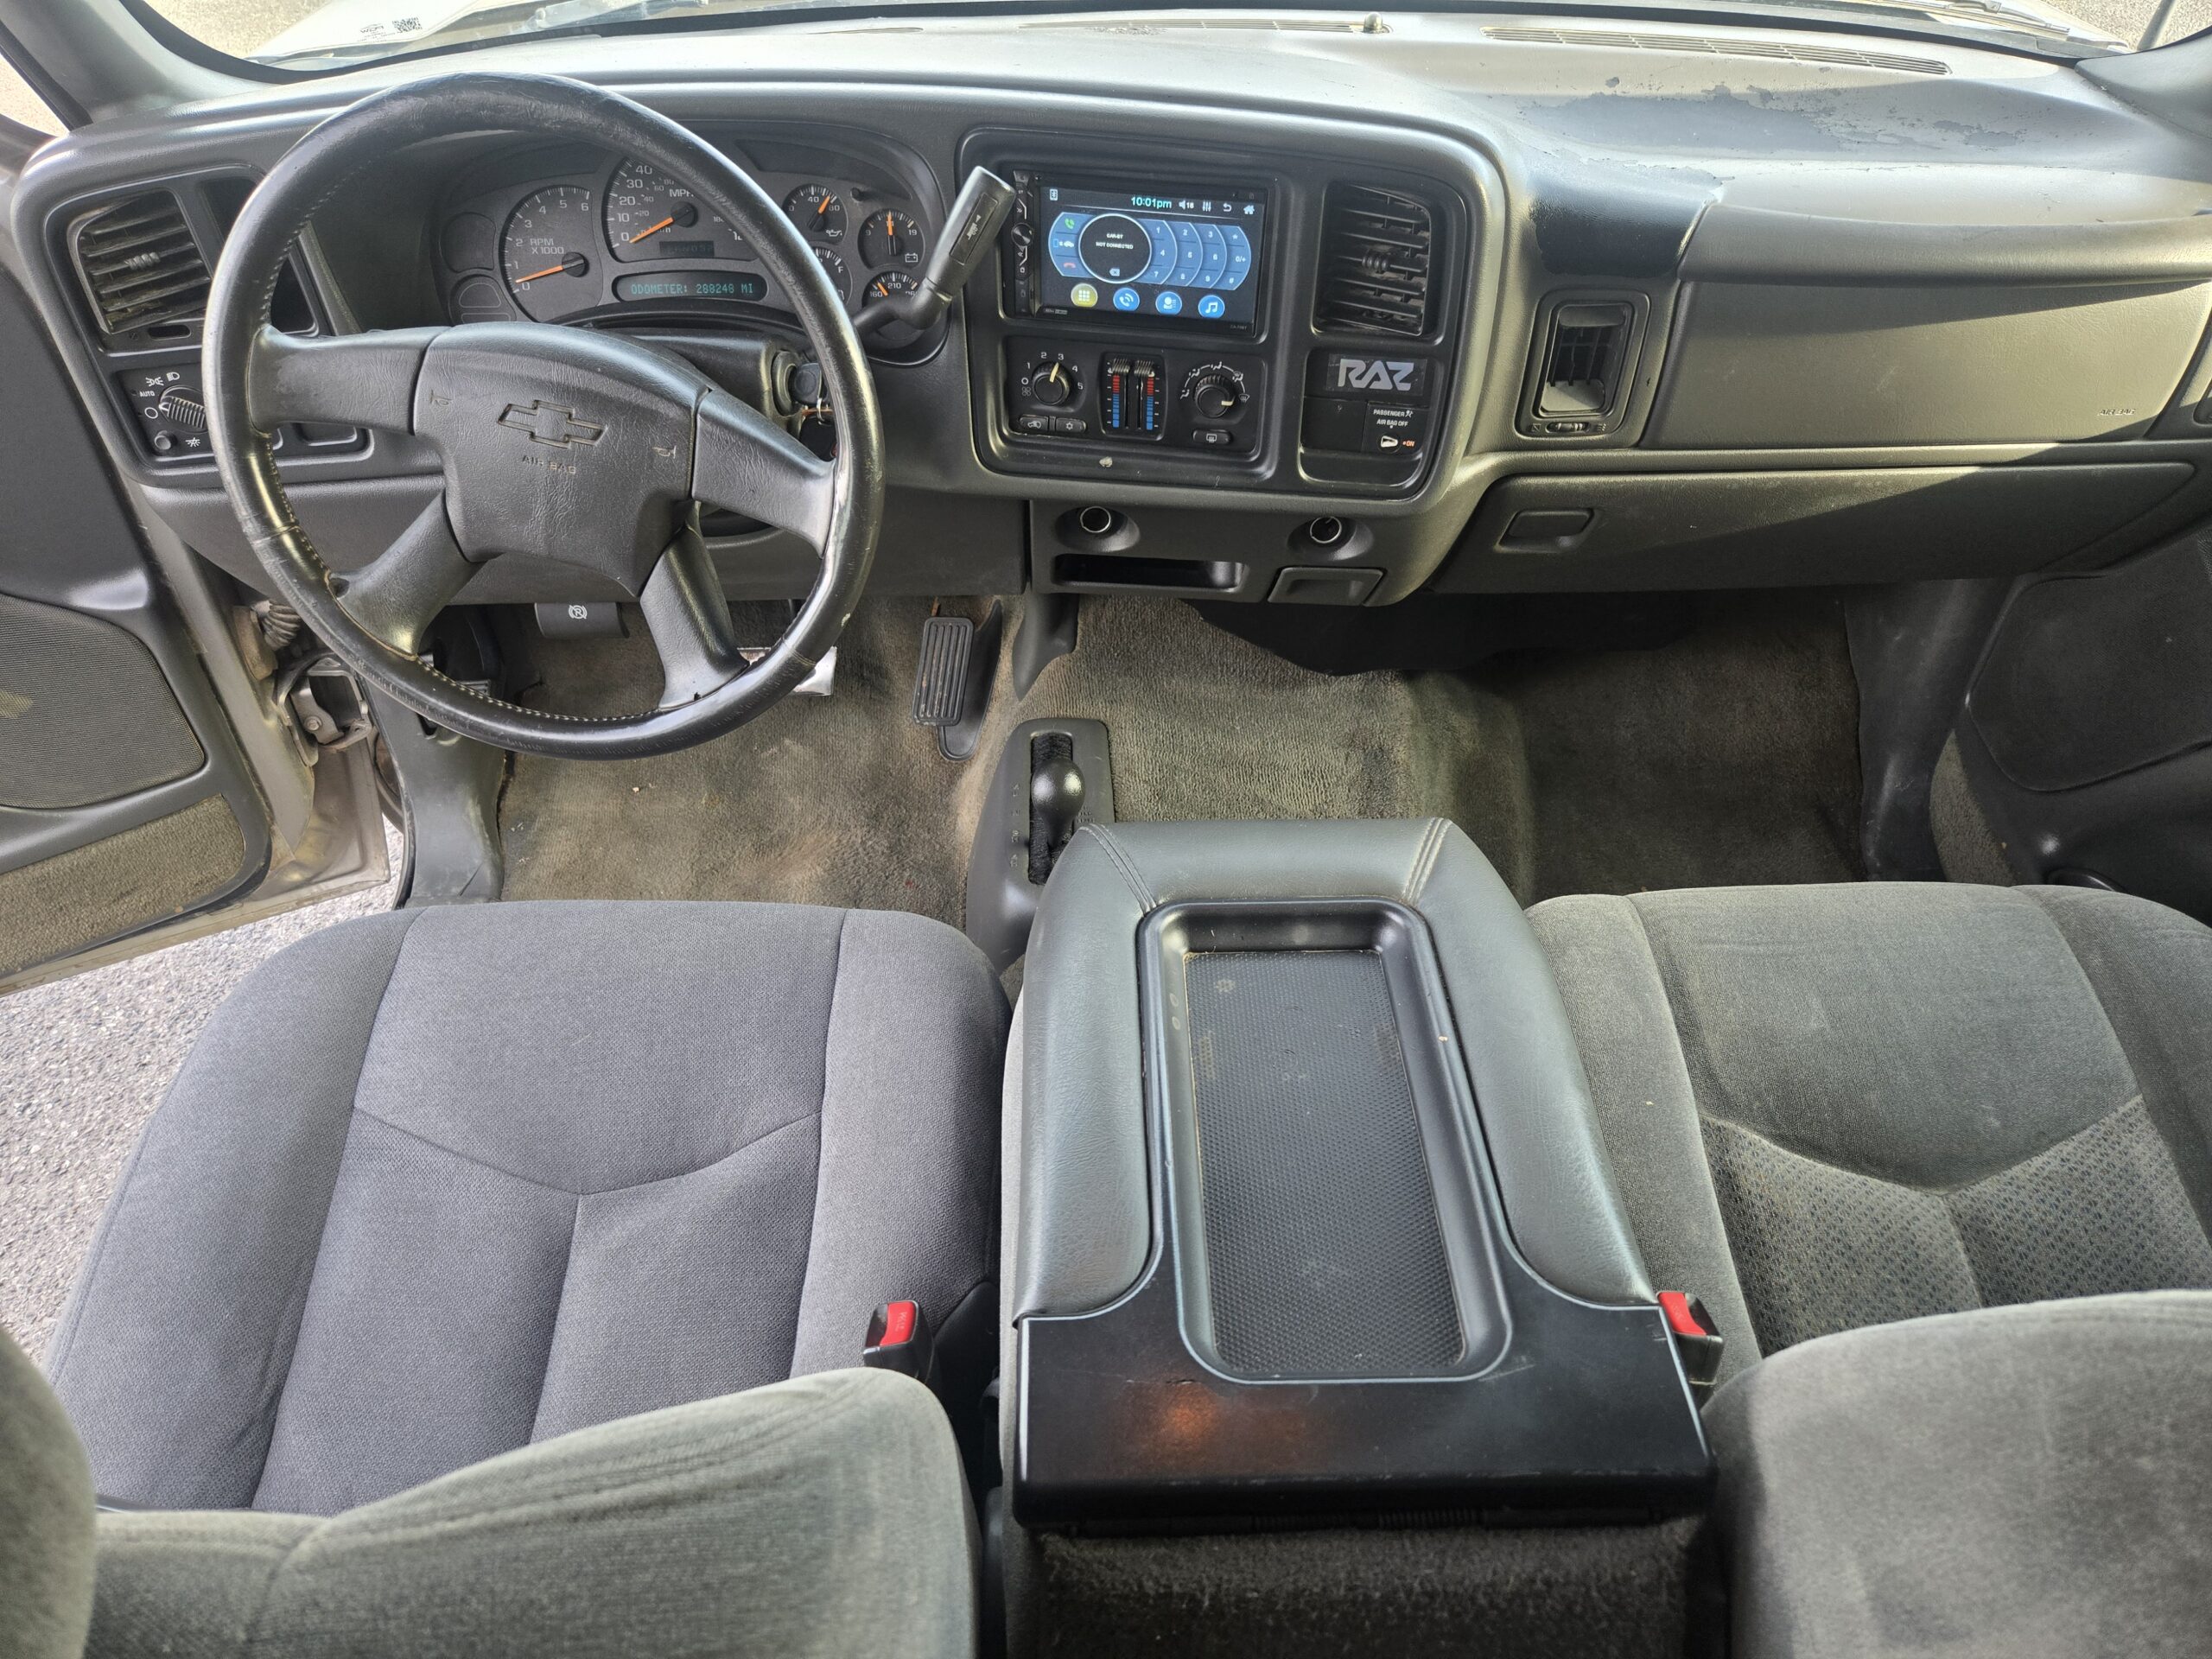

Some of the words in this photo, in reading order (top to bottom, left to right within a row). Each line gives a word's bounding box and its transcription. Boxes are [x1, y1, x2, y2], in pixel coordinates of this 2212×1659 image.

[636, 165, 652, 175] 40
[626, 179, 643, 188] 30
[559, 200, 568, 208] 5
[619, 196, 635, 206] 20
[1131, 196, 1172, 209] 10:01pm
[538, 206, 547, 214] 4
[581, 203, 589, 212] 6
[617, 213, 630, 222] 10
[524, 219, 532, 228] 3
[621, 232, 630, 241] 0
[515, 238, 523, 247] 2
[530, 238, 554, 246] RPM
[514, 261, 518, 270] 1
[522, 282, 530, 290] 0
[631, 283, 688, 295] ODOMETER:
[741, 283, 753, 294] MI
[1338, 359, 1414, 391] RAZ
[1373, 409, 1405, 417] PASSENGER
[522, 455, 544, 467] AIR
[548, 461, 576, 475] BAG
